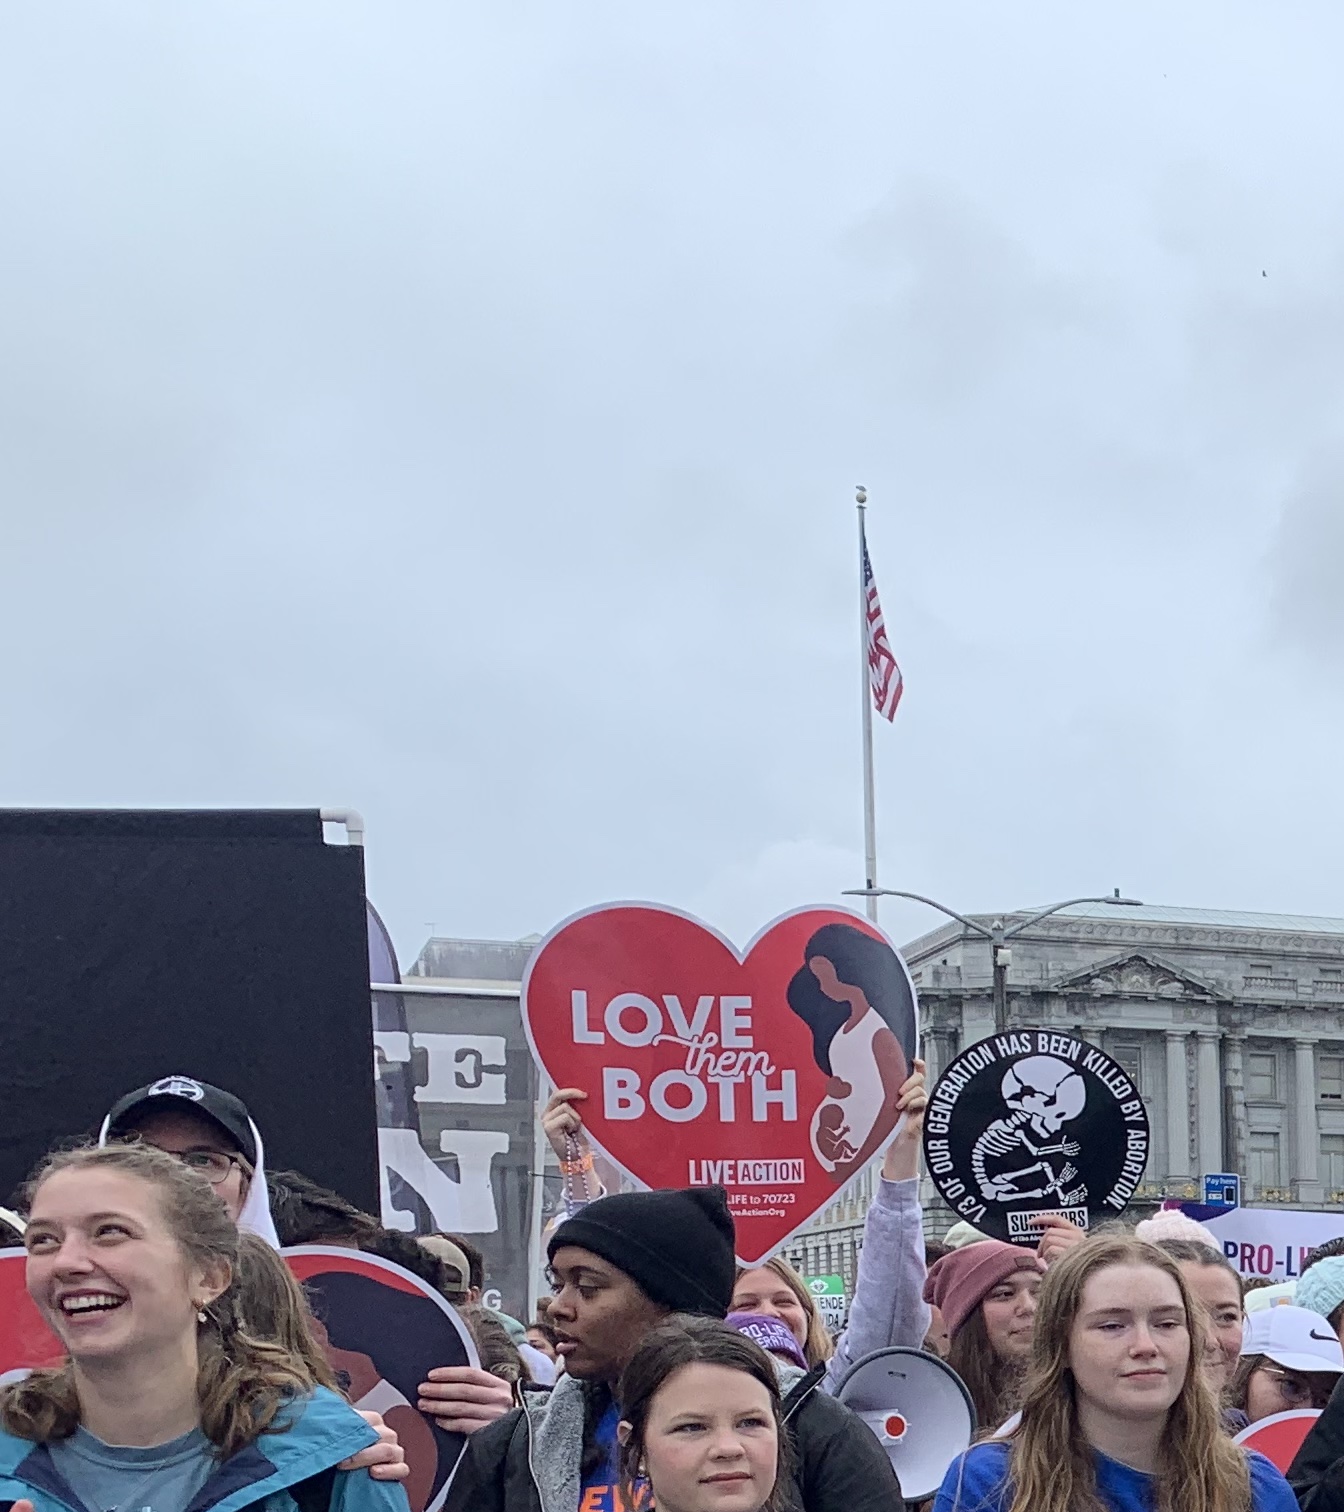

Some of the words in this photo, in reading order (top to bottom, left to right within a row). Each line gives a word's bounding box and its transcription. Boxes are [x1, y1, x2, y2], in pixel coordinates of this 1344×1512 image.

[571, 989, 754, 1048] LOVE
[652, 1032, 776, 1077] them
[995, 1033, 1032, 1058] HAS
[1037, 1032, 1082, 1061] BEEN
[927, 1043, 996, 1134] GENERATION
[1082, 1049, 1134, 1107] KILLED
[602, 1066, 798, 1123] BOTH
[1120, 1099, 1146, 1123] BY
[927, 1138, 954, 1175] OUR
[1102, 1128, 1147, 1211] ABORTION.
[689, 1159, 735, 1185] LIVE
[740, 1161, 802, 1182] ACTION
[1205, 1177, 1220, 1187] Pay
[1219, 1177, 1237, 1185] here
[750, 1194, 761, 1205] to
[762, 1193, 796, 1204] 70723
[938, 1176, 967, 1200] OF
[957, 1195, 988, 1224] 1/3
[1010, 1208, 1087, 1232] SURRS
[1223, 1240, 1314, 1278] PRO-LI
